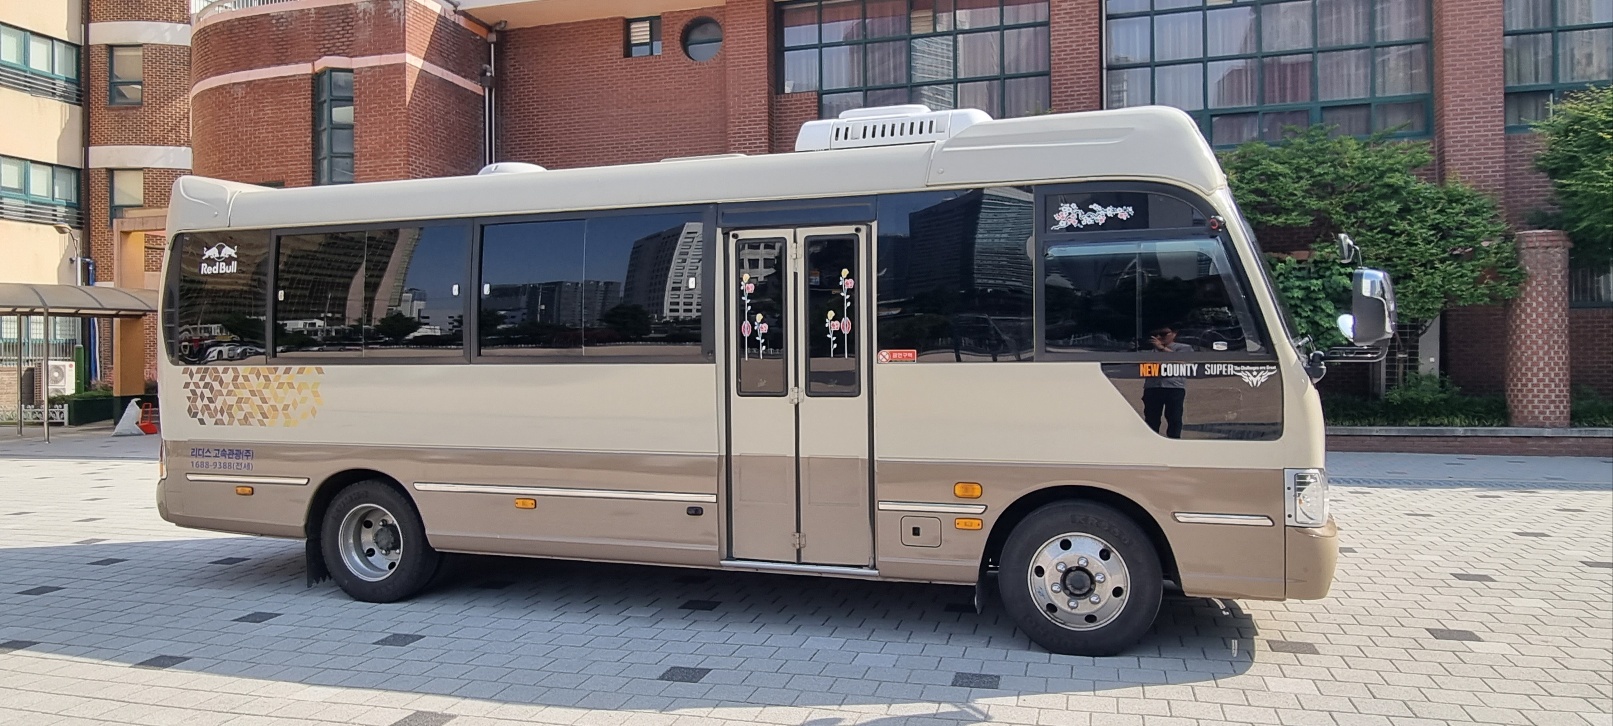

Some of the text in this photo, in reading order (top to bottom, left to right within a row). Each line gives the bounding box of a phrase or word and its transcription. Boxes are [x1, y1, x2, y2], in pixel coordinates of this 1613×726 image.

[201, 261, 237, 275] Red Bull
[1140, 363, 1234, 377] NEW COUNTY SUPER
[190, 447, 254, 461] 리더스 고속관광(주)
